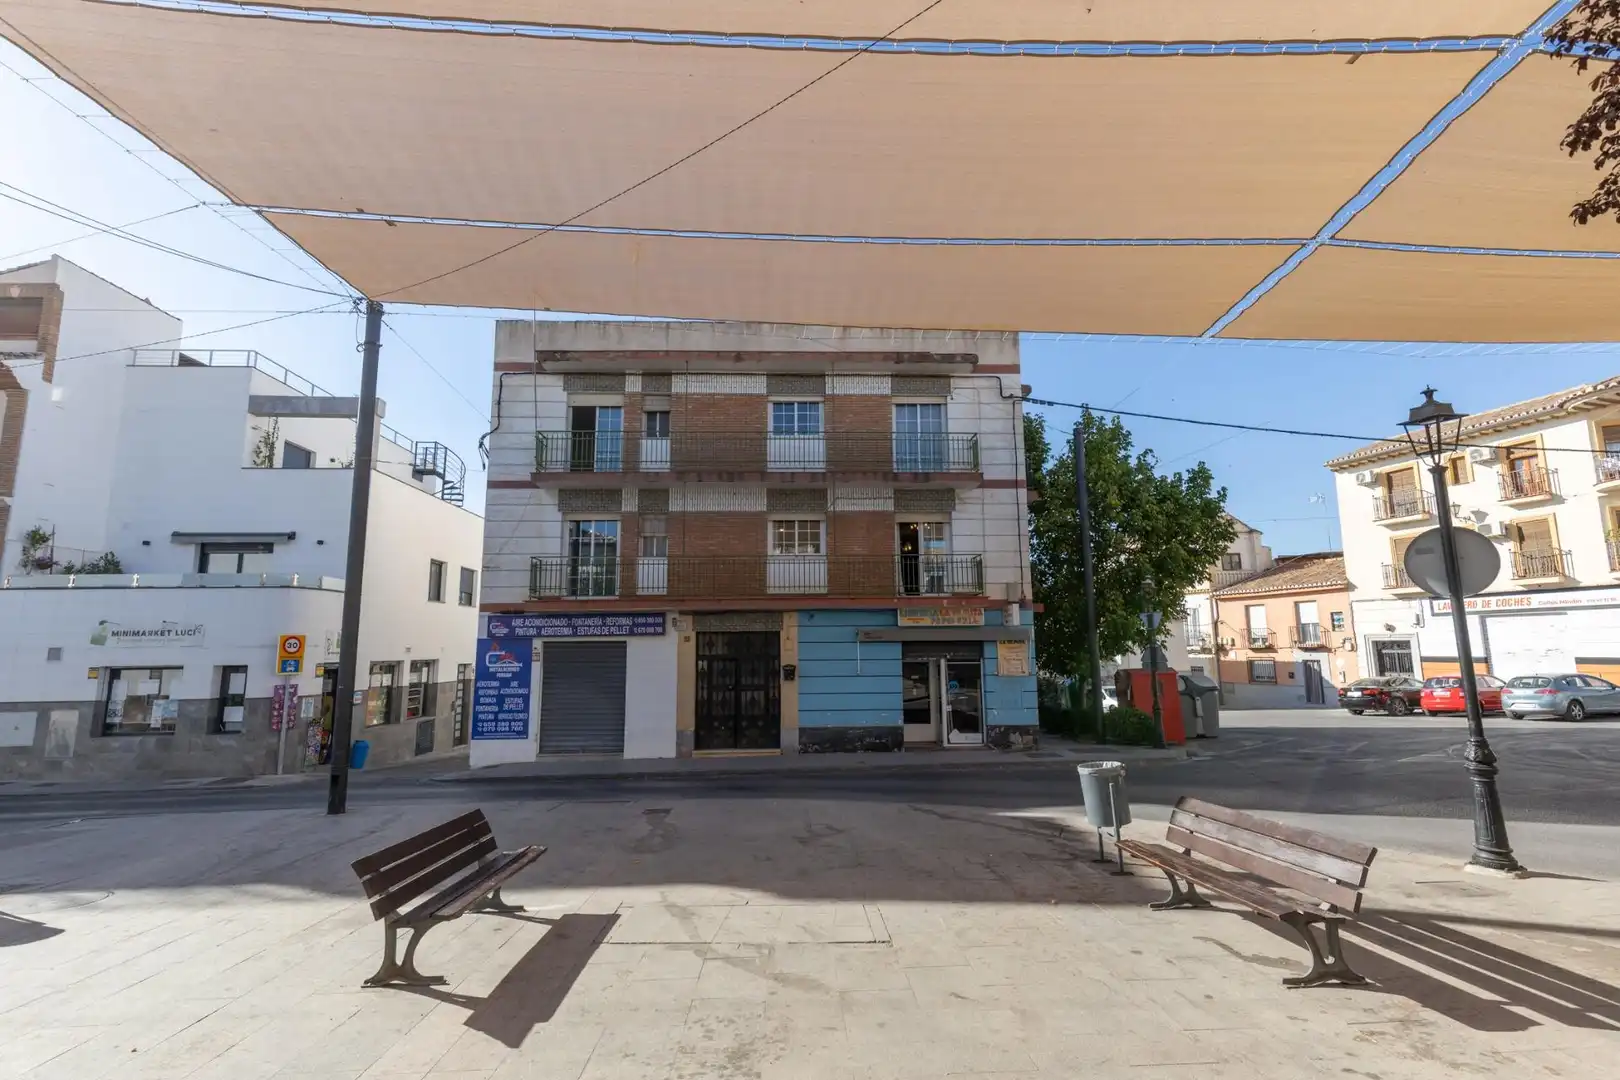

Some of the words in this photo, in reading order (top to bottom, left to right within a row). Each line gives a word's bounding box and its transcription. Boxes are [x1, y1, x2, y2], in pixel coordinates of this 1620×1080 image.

[1437, 600, 1478, 611] LAVERO
[1481, 599, 1492, 609] DE
[1495, 597, 1532, 608] COCHES
[511, 618, 524, 627] AIRE
[525, 617, 568, 627] ACONDICIONADO
[571, 616, 602, 626] FONTANERÍA
[605, 617, 633, 626] REFORMAS
[111, 629, 172, 637] MINIMARKET
[515, 627, 537, 636] PINTURA
[541, 627, 573, 635] AEROTERMIA
[577, 626, 601, 635] ESTUFAS
[601, 627, 610, 635] DE
[611, 626, 630, 635] PELLET
